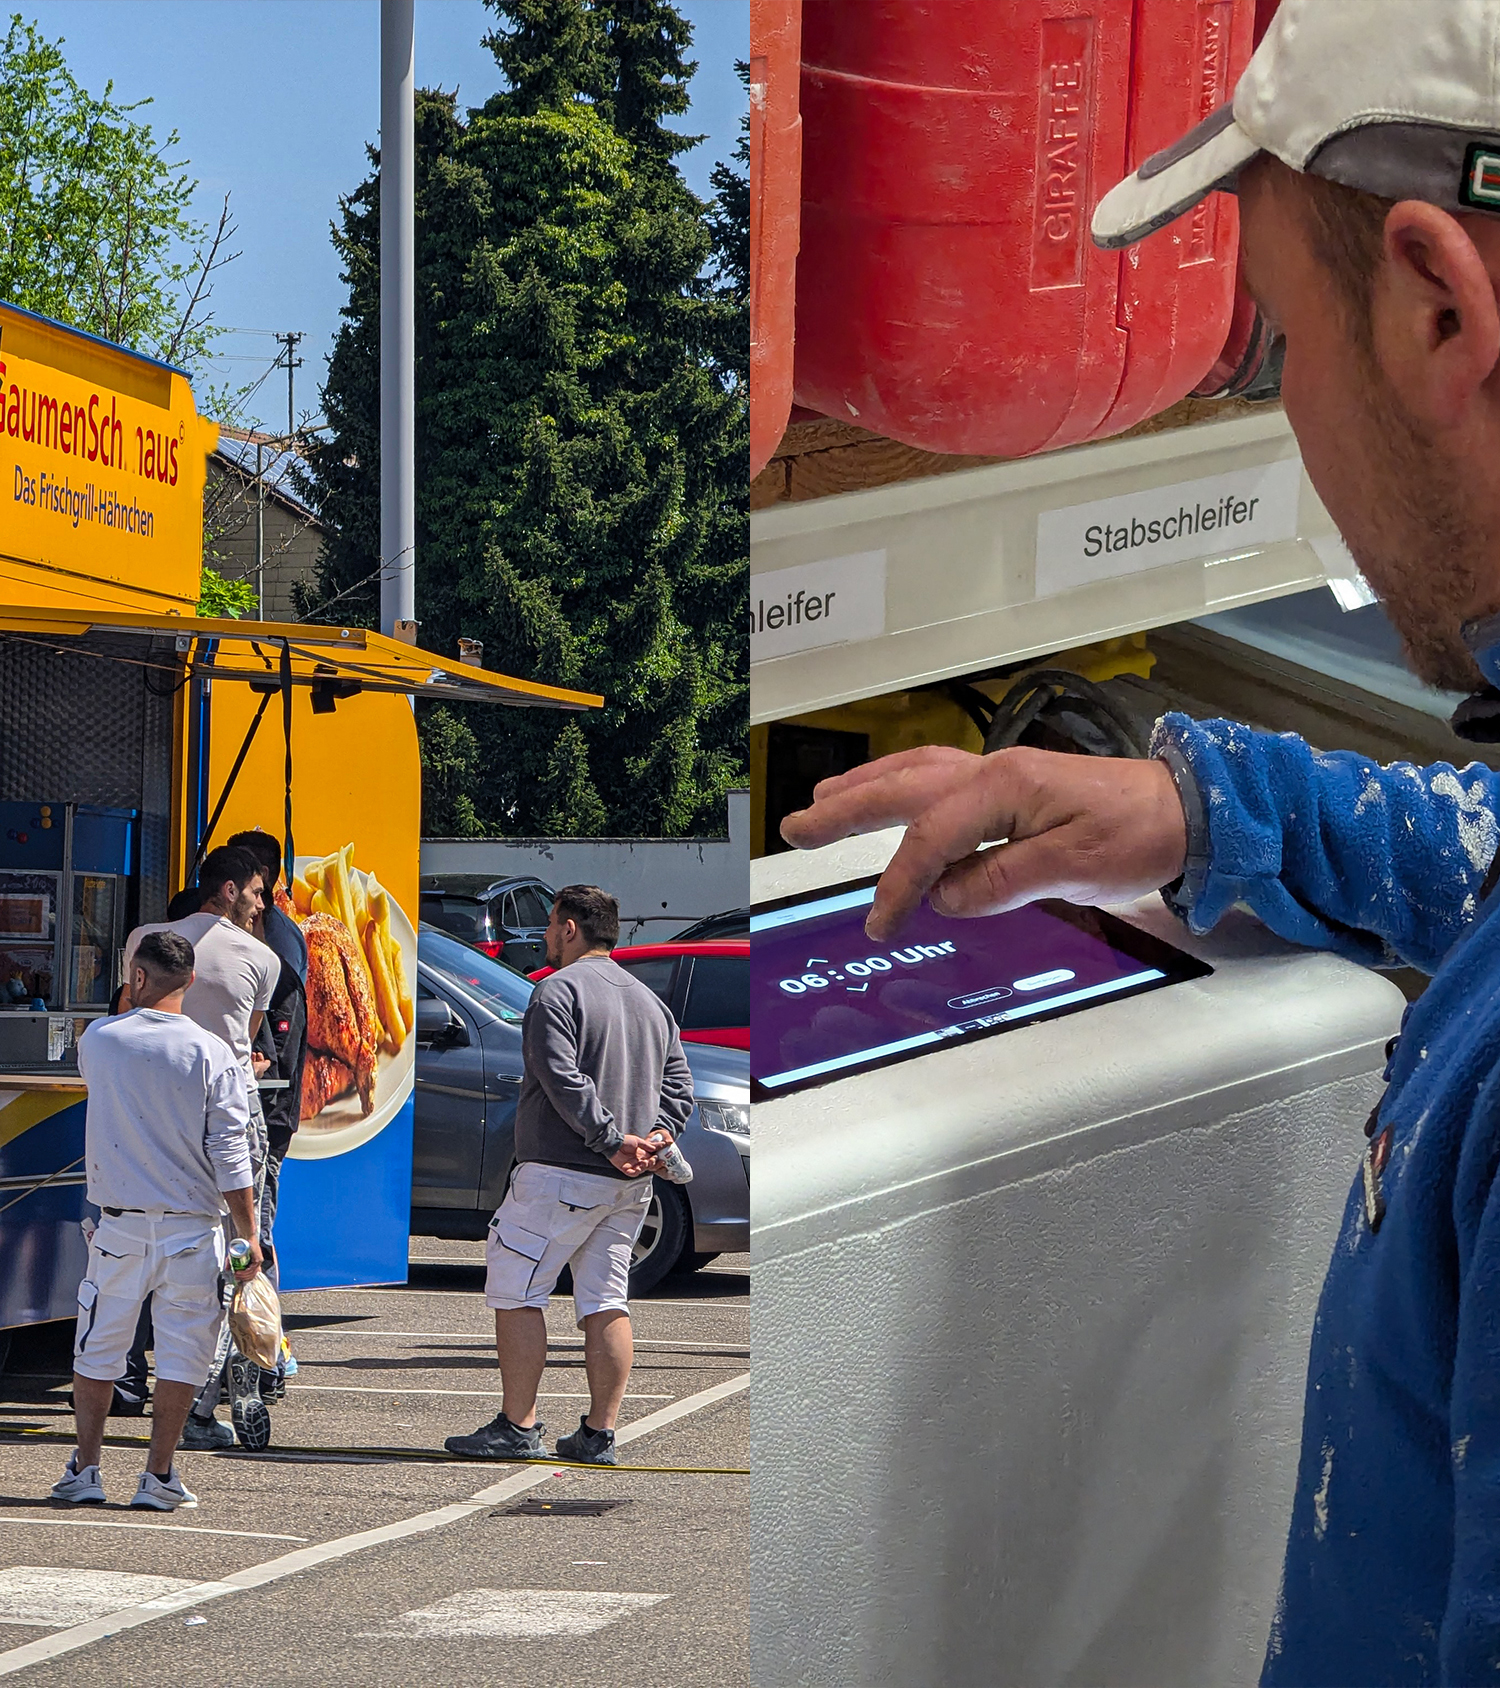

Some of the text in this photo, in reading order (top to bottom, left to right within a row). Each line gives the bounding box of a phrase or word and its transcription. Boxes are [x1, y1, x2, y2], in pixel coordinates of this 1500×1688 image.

[1043, 62, 1081, 240] GIRAFFE
[14, 464, 154, 538] Das Frischgrill-Hähnchen
[1083, 495, 1260, 557] Stabschleifer
[890, 940, 957, 964] Uhr
